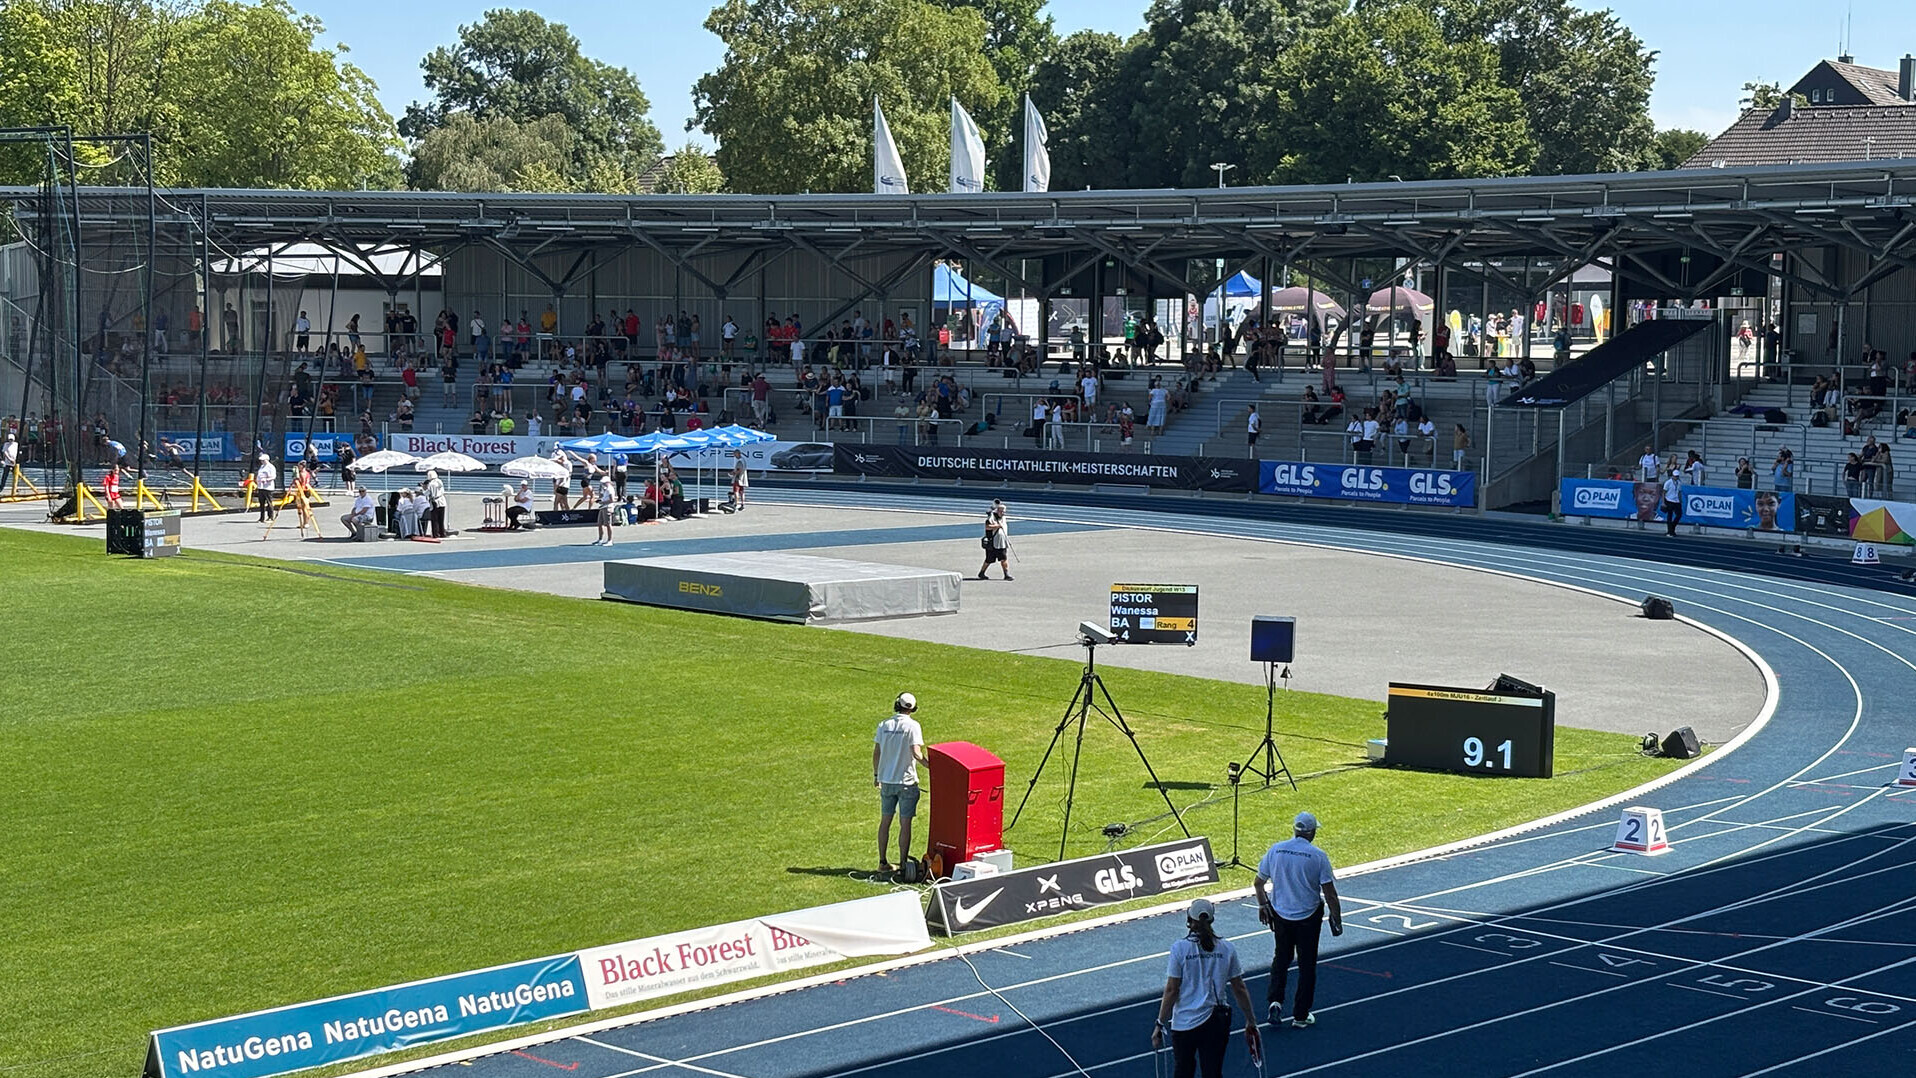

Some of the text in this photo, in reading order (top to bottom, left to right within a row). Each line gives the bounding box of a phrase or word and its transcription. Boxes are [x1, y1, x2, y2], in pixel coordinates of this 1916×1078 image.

[408, 436, 517, 455] Black Forest
[697, 448, 764, 459] XPENG
[918, 456, 1178, 479] DEUTSCHE LEICHTATHLETIK-MEISTERSCHAFTEN
[1592, 492, 1618, 502] PLAN
[1706, 500, 1732, 511] PLAN
[1856, 547, 1862, 557] 8
[1867, 547, 1874, 558] 8
[678, 581, 720, 597] BENZ
[1111, 593, 1153, 603] PISTOR
[1111, 606, 1159, 615] Wanessa
[1111, 617, 1194, 629] BA Rang 4
[1121, 630, 1195, 641] 4 X
[1463, 736, 1512, 770] 9.1
[1624, 818, 1640, 842] 2
[1651, 818, 1661, 842] 2
[1176, 851, 1203, 866] PLAN
[1094, 865, 1143, 894] GLS.
[1025, 893, 1083, 914] XPENG
[1368, 914, 1438, 930] 2
[1474, 933, 1542, 949] 3
[598, 933, 757, 986] Black Forest
[1597, 952, 1657, 967] 4
[605, 990, 619, 1000] Das
[619, 985, 637, 997] stille
[637, 977, 687, 994] Mineralwasser
[687, 974, 700, 983] aus
[700, 970, 715, 980] dem
[1696, 974, 1775, 992] 5
[1824, 997, 1901, 1014] 6
[178, 976, 575, 1074] NatuGena NatuGena NatuGena
